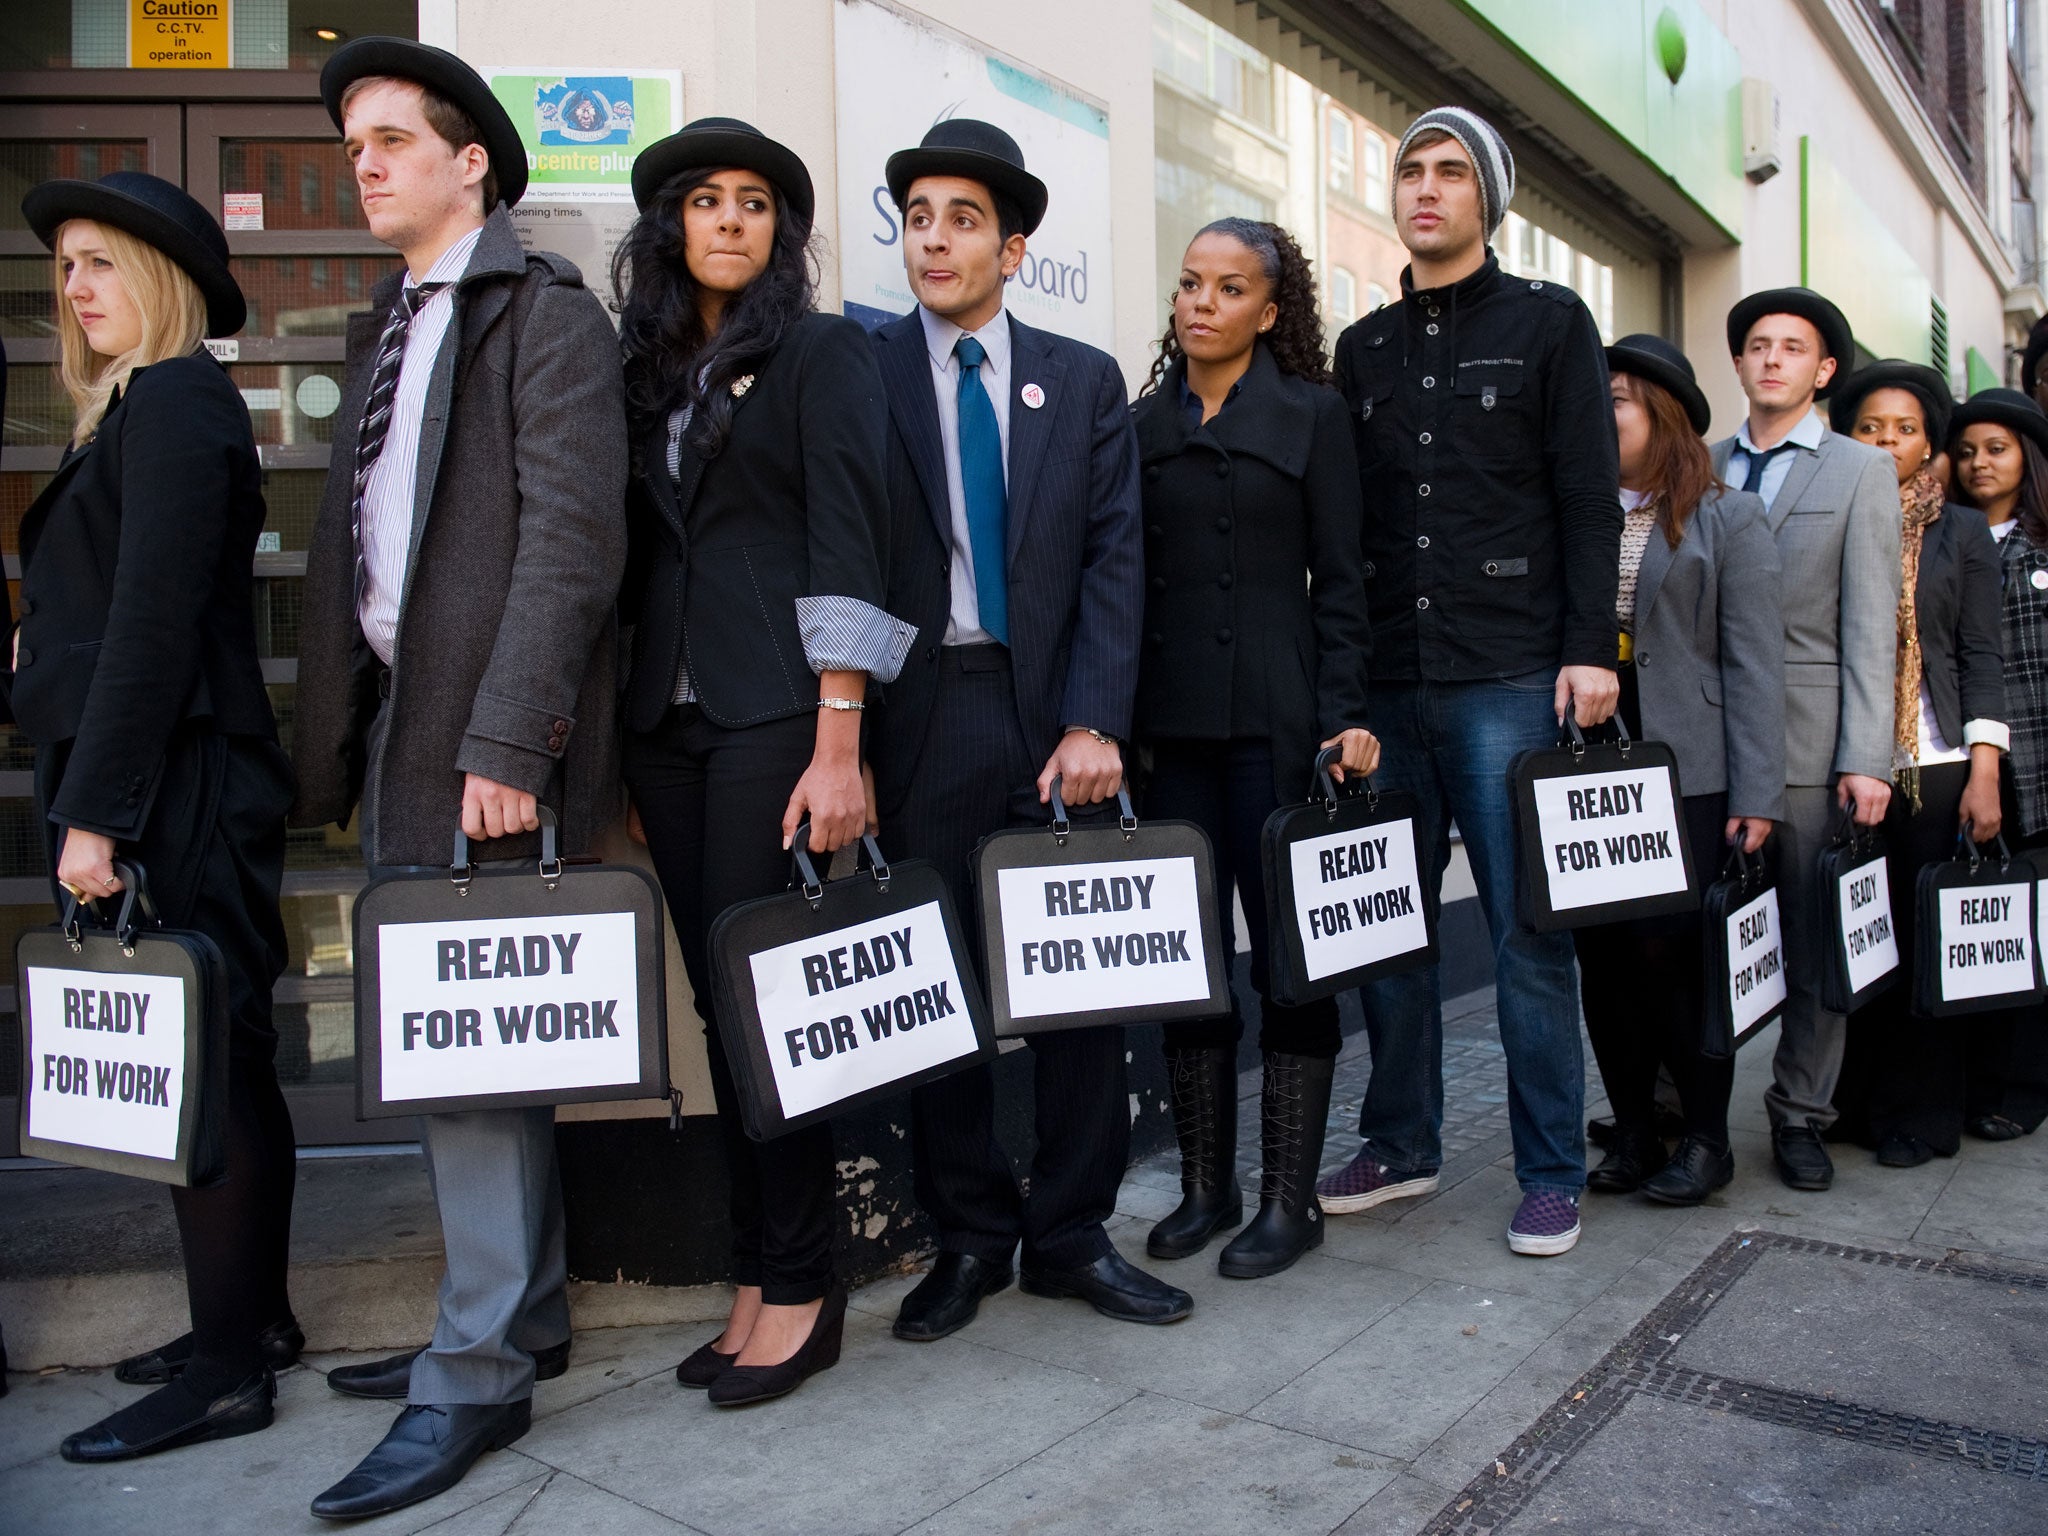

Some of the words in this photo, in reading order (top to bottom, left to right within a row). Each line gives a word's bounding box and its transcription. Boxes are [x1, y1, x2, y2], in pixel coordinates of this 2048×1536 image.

[143, 0, 217, 16] Caution
[149, 50, 212, 62] operation
[174, 36, 186, 46] in
[508, 207, 551, 219] Opening
[553, 208, 583, 217] times
[1017, 290, 1061, 313] LIMITED
[208, 344, 228, 356] PULL
[1503, 358, 1524, 366] DELUXE
[1568, 783, 1643, 821] READY
[1320, 837, 1387, 883] READY
[1555, 836, 1601, 873] FOR
[1604, 831, 1672, 865] WORK
[1045, 875, 1155, 916] READY
[1308, 902, 1352, 940] FOR
[1353, 885, 1414, 927] WORK
[1850, 874, 1876, 911] READY
[1961, 896, 2010, 925] READY
[1739, 906, 1768, 950] READY
[1849, 928, 1866, 959] FOR
[1865, 914, 1891, 948] WORK
[438, 933, 581, 981] READY
[802, 927, 912, 996] READY
[1022, 935, 1086, 975] FOR
[1092, 930, 1190, 968] WORK
[1736, 966, 1753, 1000] FOR
[1754, 946, 1780, 986] WORK
[1949, 943, 1977, 968] FOR
[1981, 938, 2025, 964] WORK
[64, 988, 150, 1035] READY
[403, 1005, 482, 1050] FOR
[494, 1000, 619, 1044] WORK
[785, 1015, 858, 1067] FOR
[861, 981, 955, 1042] WORK
[44, 1055, 87, 1095] FOR
[95, 1060, 170, 1107] WORK
